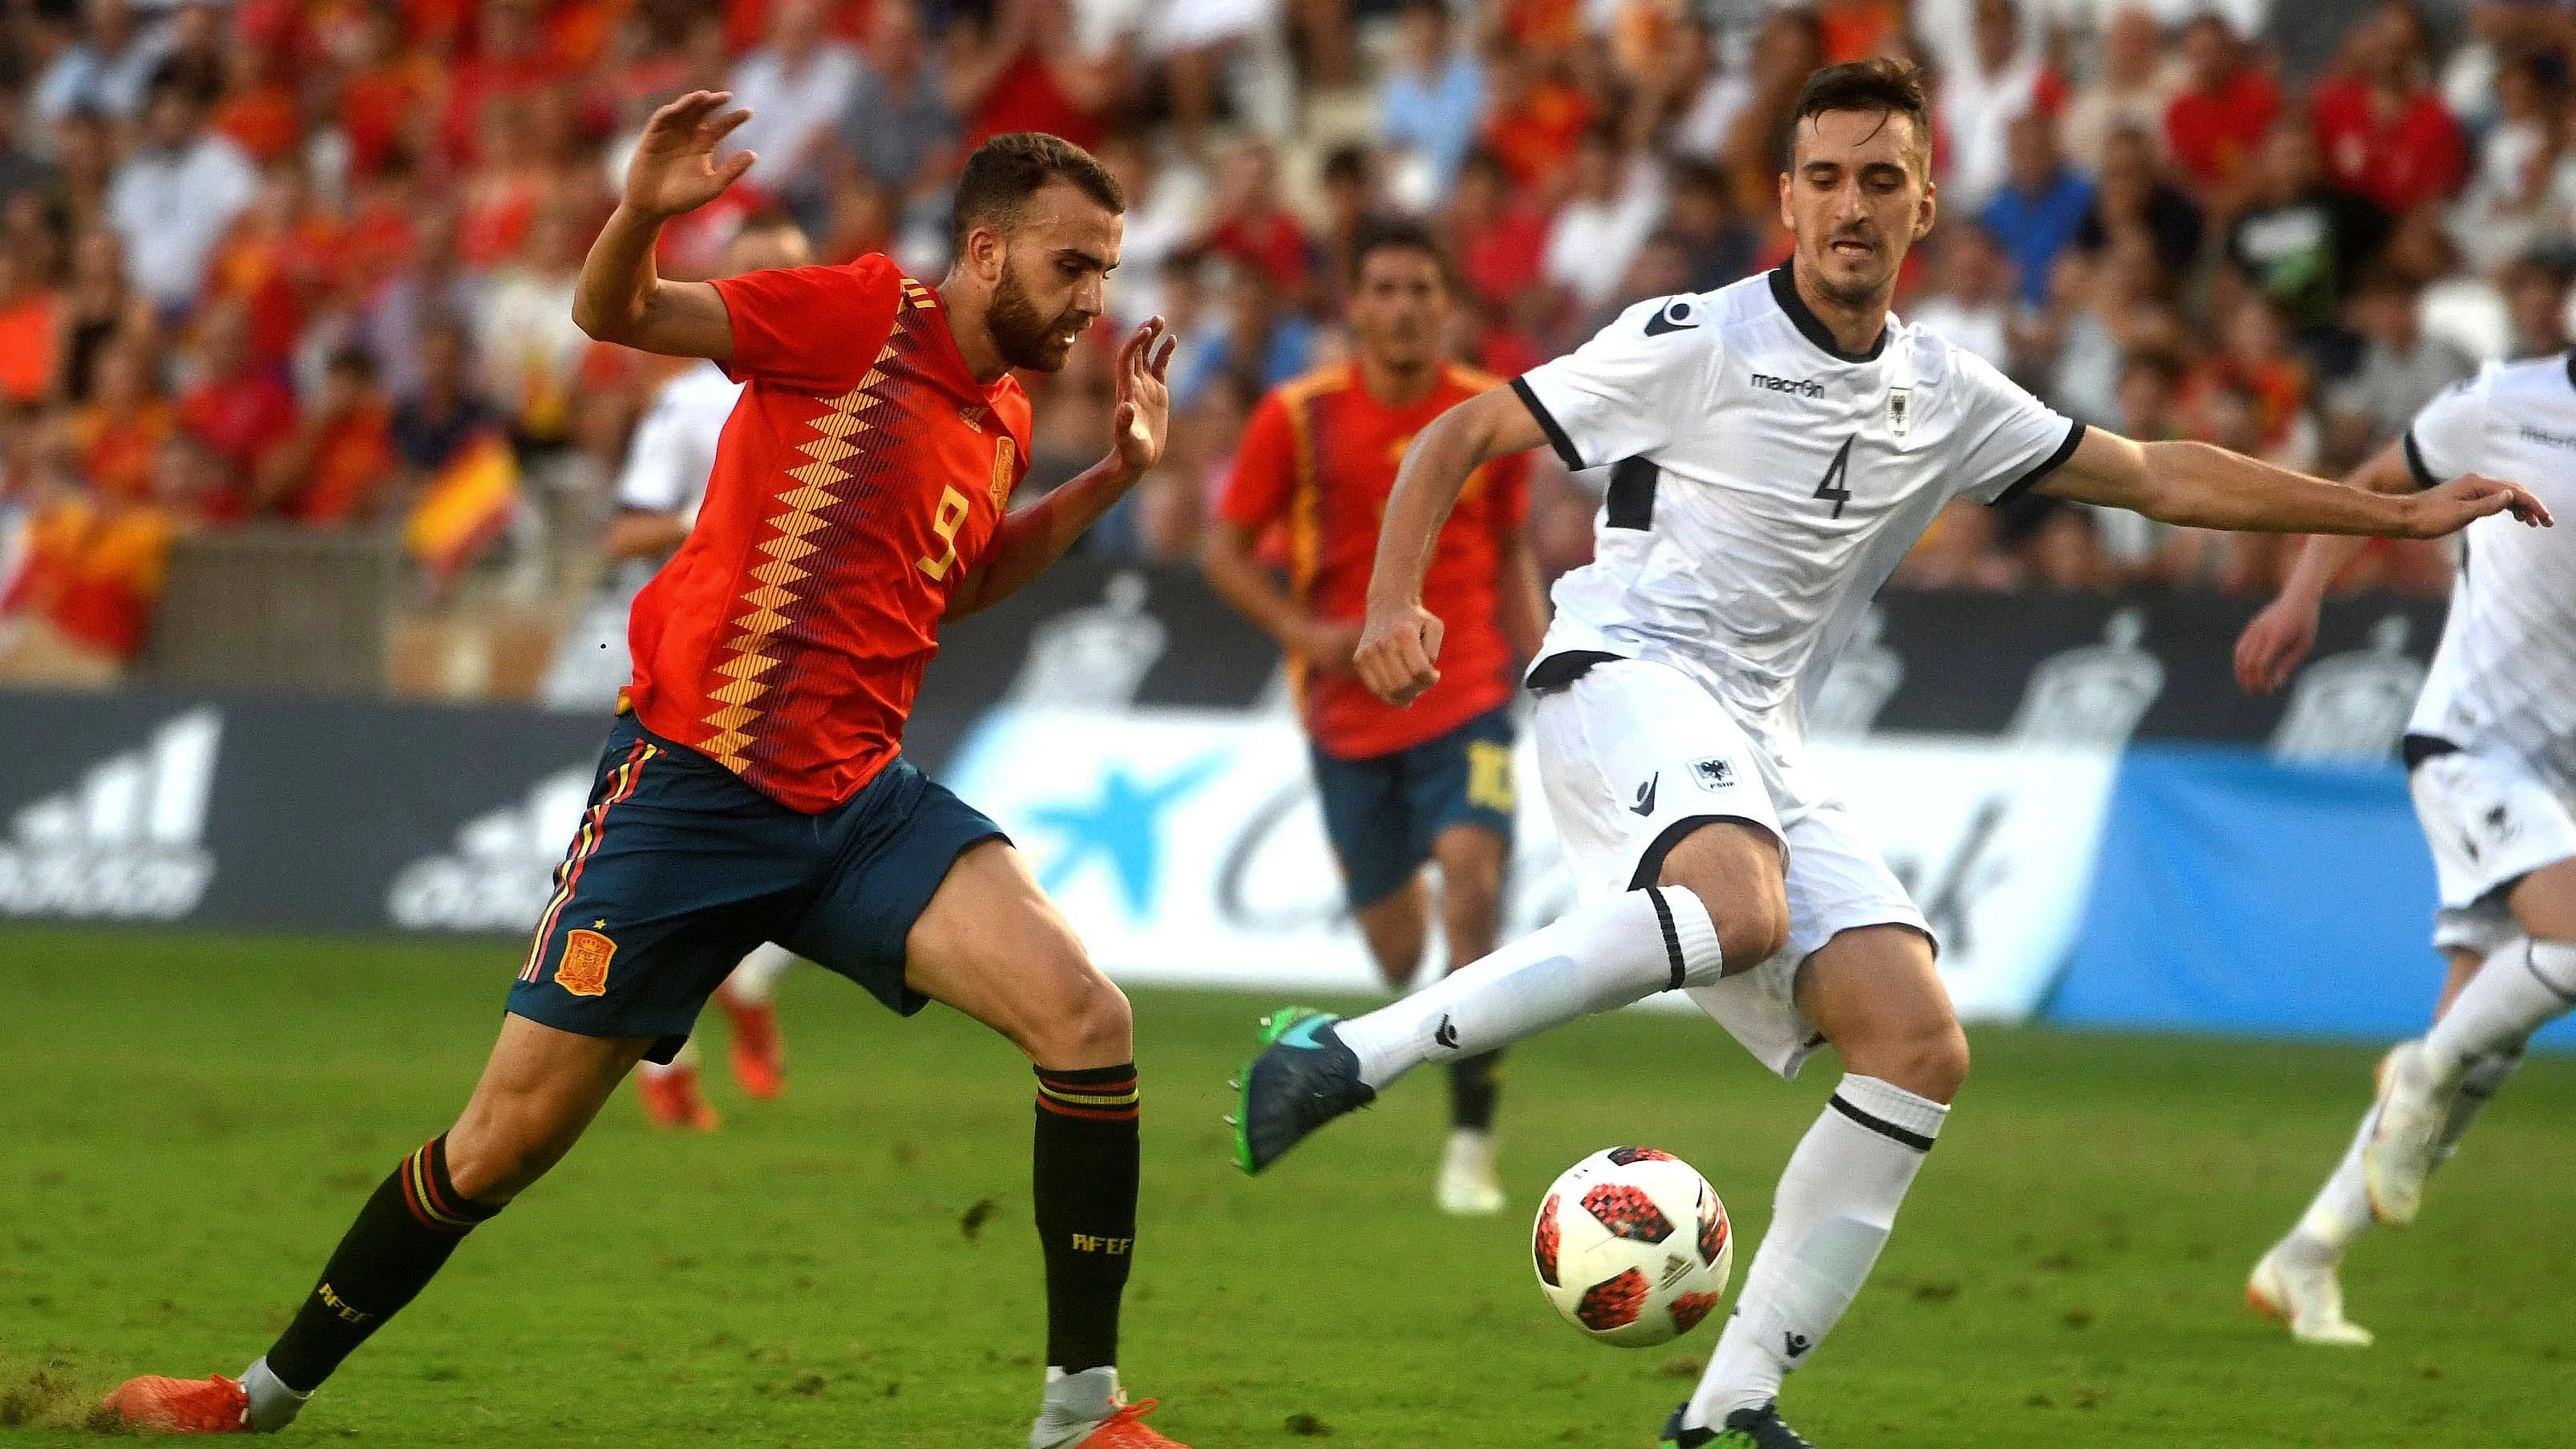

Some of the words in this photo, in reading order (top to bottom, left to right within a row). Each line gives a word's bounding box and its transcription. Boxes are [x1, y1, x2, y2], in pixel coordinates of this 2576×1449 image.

[1750, 373, 1825, 399] macron
[1812, 431, 1858, 520] 4
[916, 484, 969, 581] 9
[1467, 738, 1517, 814] 10
